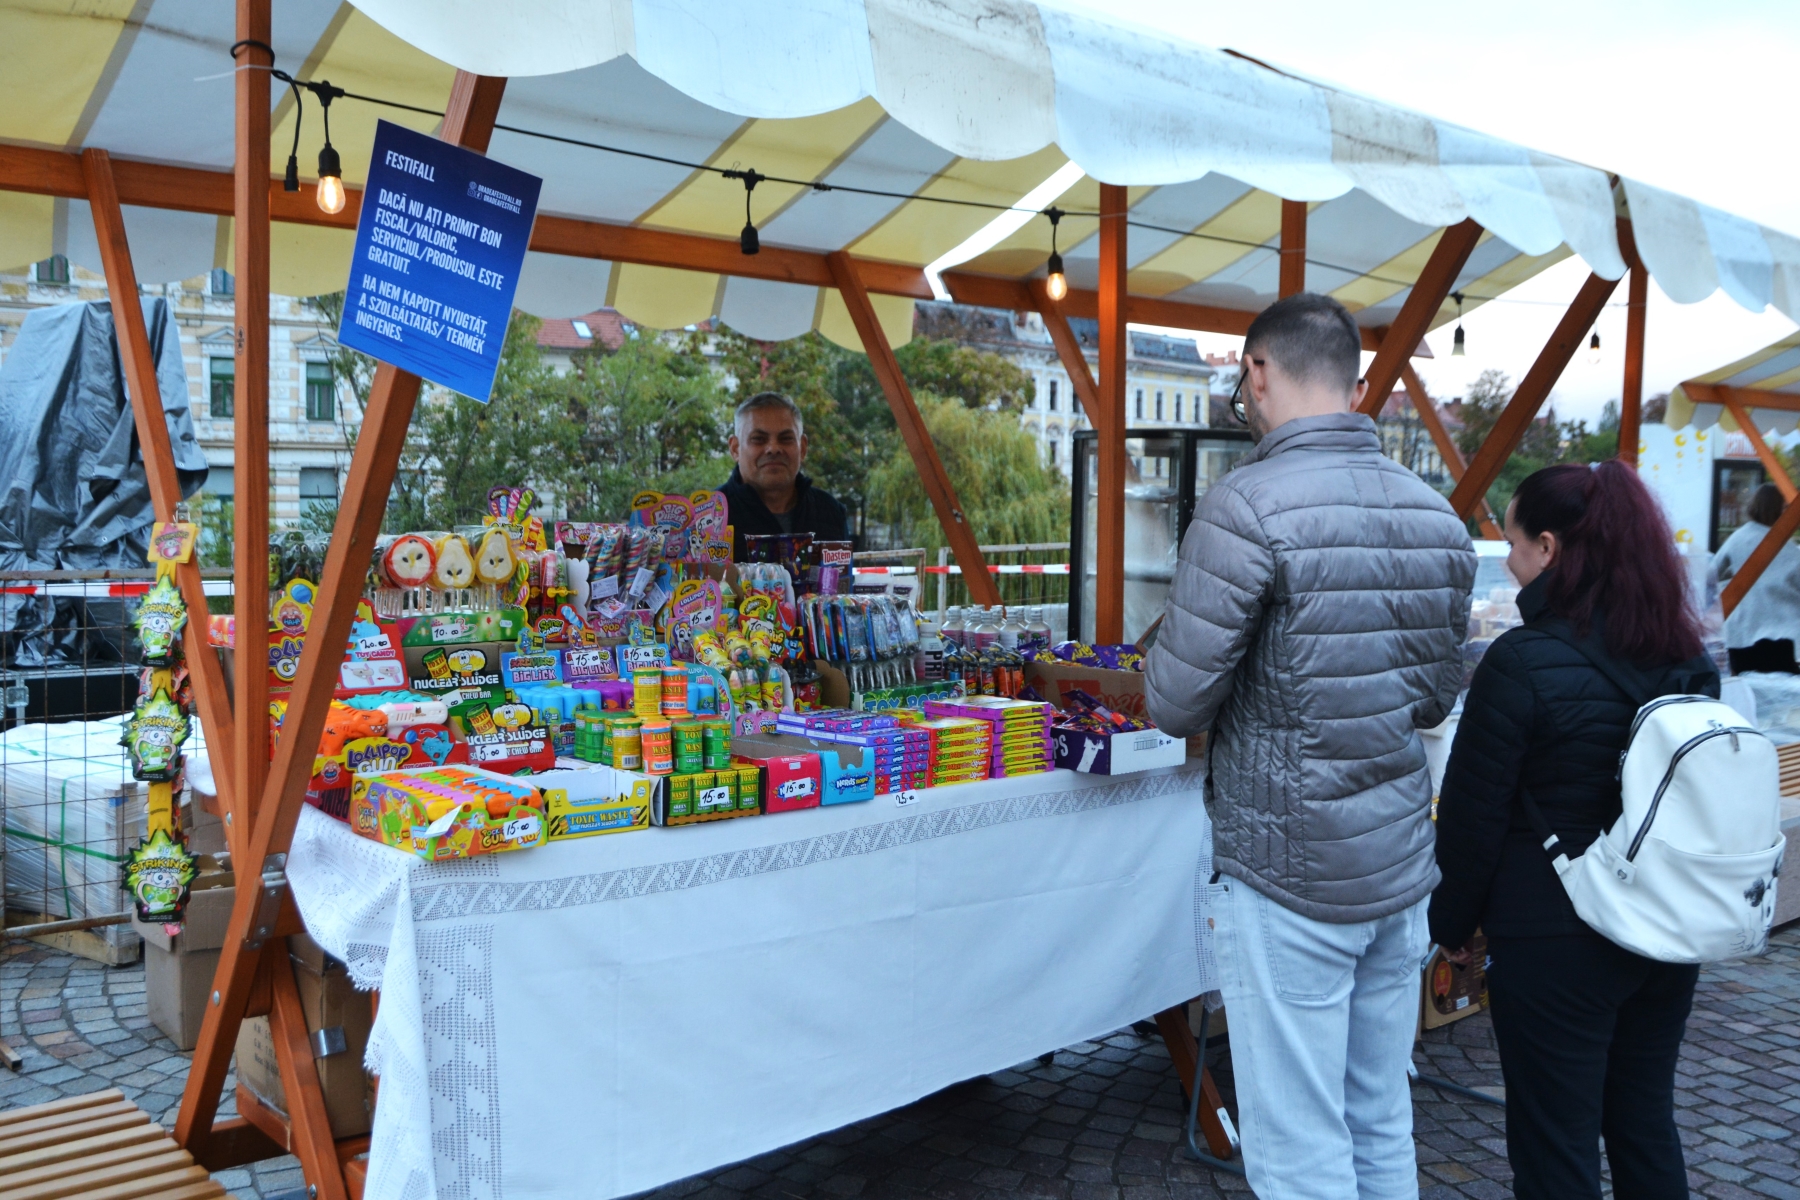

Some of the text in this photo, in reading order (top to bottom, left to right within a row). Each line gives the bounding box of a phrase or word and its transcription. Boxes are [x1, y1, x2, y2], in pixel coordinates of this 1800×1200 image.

[385, 149, 435, 183] FESTIFALL
[378, 187, 408, 213] DACĂ
[407, 199, 424, 219] NU
[443, 212, 480, 240] PRIMIT
[479, 226, 503, 249] BON
[375, 207, 458, 255] FISCAL/VALORIC,
[367, 244, 411, 275] GRATUIT.
[371, 226, 504, 291] SERVICIUL/PRODUSUL ESTE
[362, 273, 488, 339] HA NEM KAPOTT NYUGTÁT,
[355, 310, 403, 343] INGYENES.
[358, 292, 486, 355] A SZOLGÁLTATÁS/ TERMÉK
[708, 547, 729, 559] POP
[138, 603, 182, 618] STRIKING
[602, 624, 620, 633] POP
[371, 649, 396, 658] CANDY
[414, 673, 500, 690] NUCLEAR SLUDGE
[479, 691, 492, 699] BAR
[132, 716, 184, 731] STRIKING
[467, 731, 505, 746] UCLEAR
[507, 727, 547, 742] SLUDGE
[348, 743, 408, 768] LOLLIPOP
[357, 756, 397, 773] GUN
[130, 858, 189, 873] STRIKING
